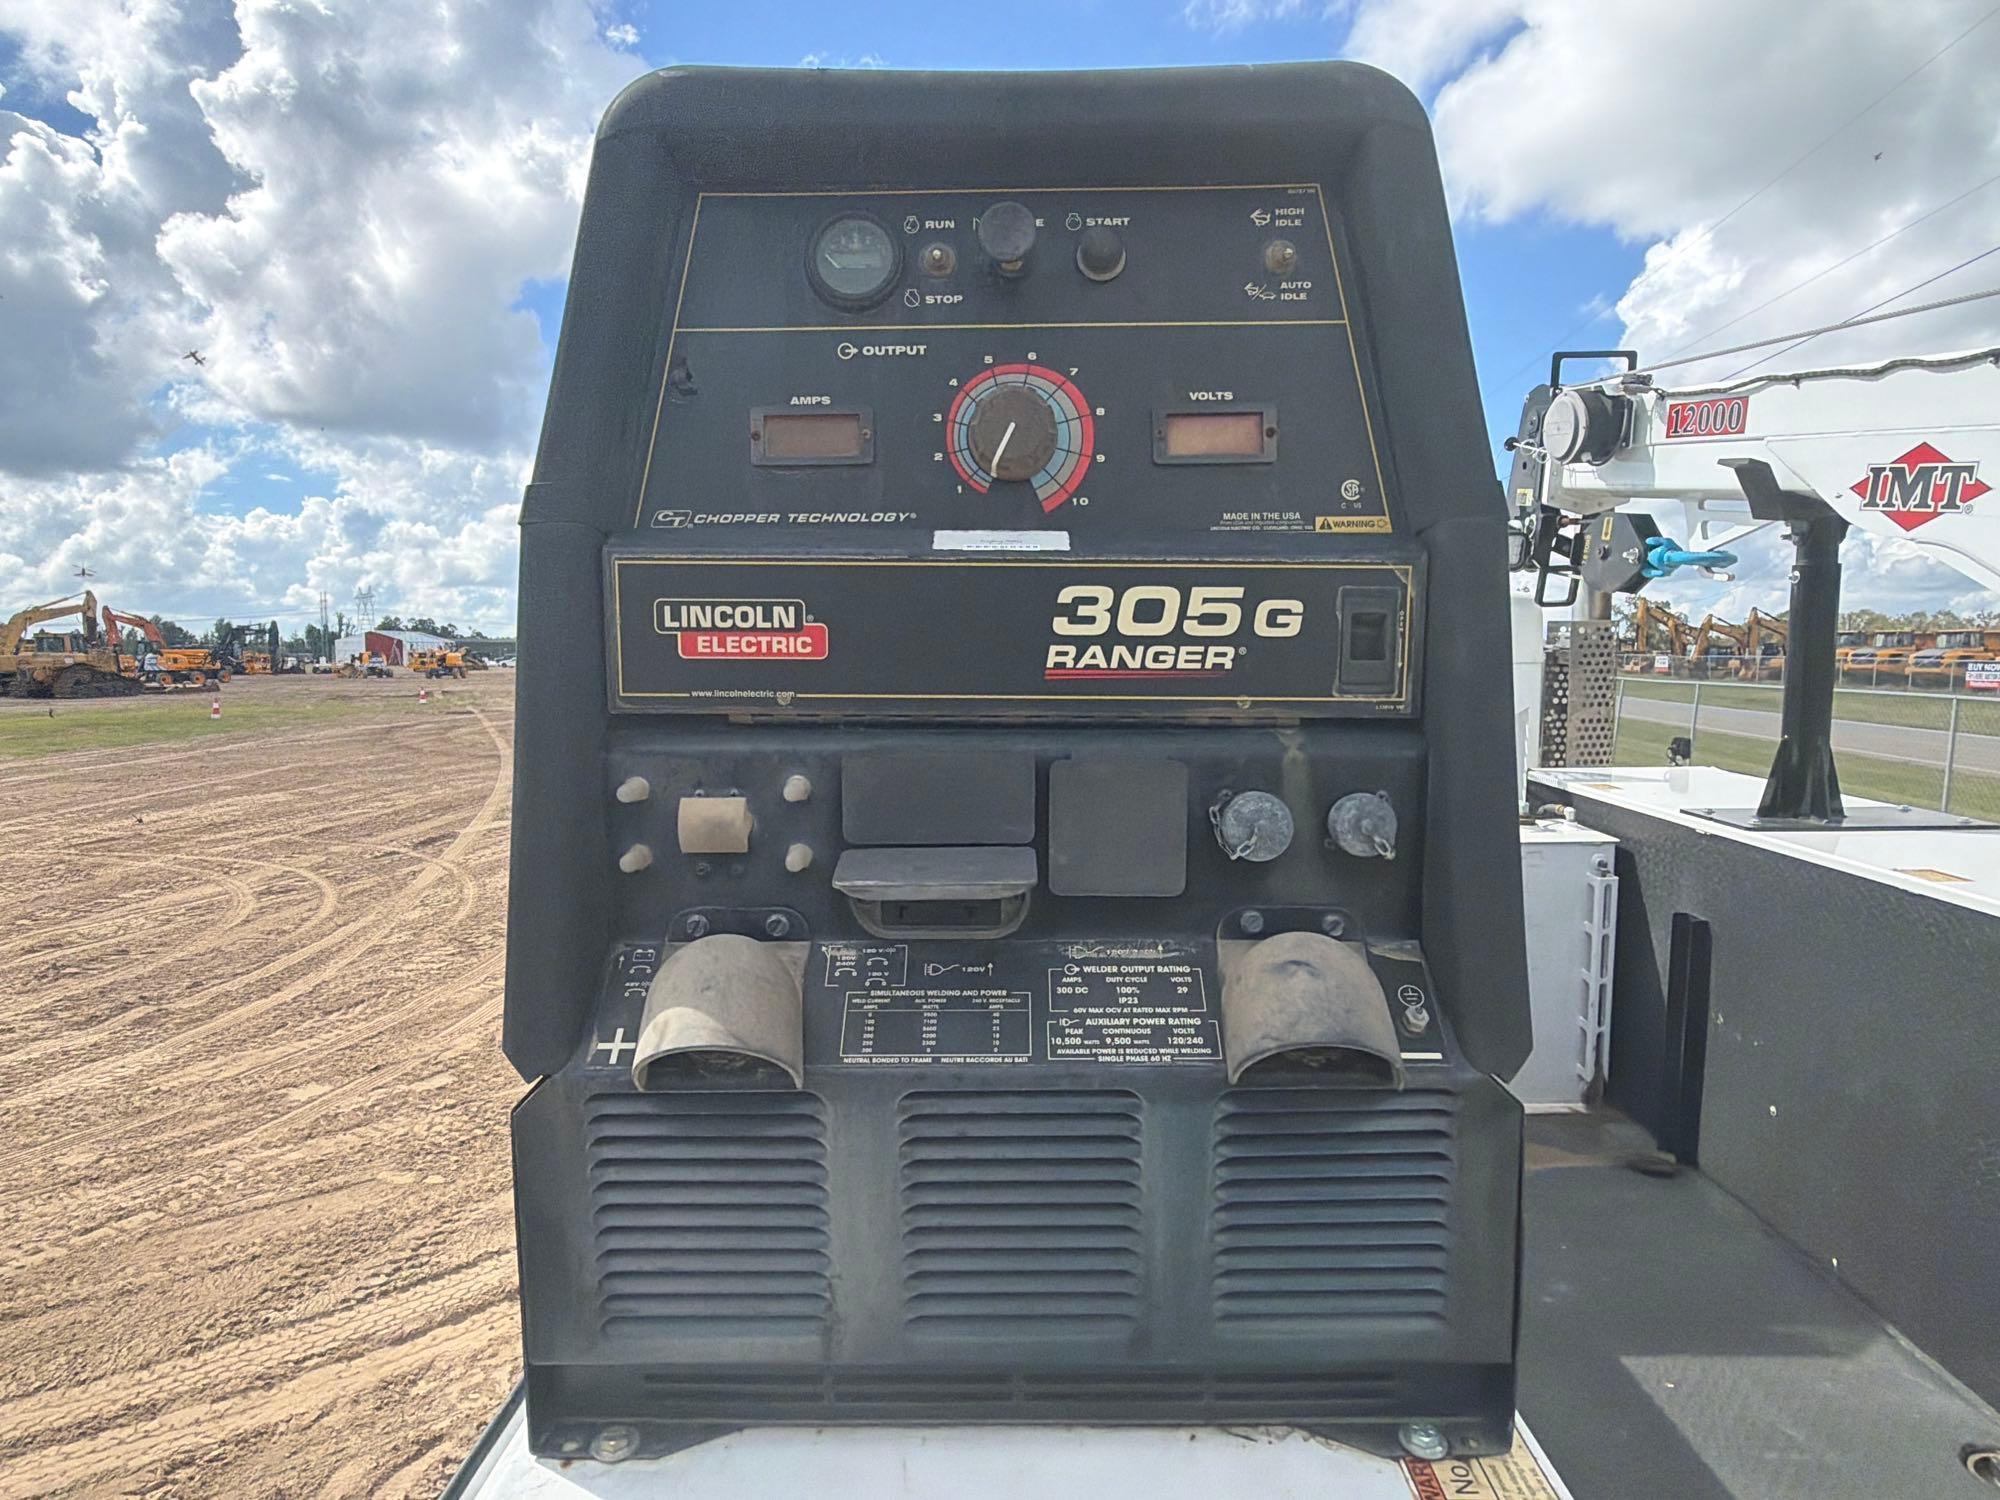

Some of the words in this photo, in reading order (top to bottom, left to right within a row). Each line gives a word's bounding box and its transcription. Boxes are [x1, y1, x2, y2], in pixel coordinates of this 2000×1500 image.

[1275, 207, 1305, 216] HIGH
[925, 219, 955, 229] RUN
[1086, 216, 1130, 227] START
[1275, 218, 1302, 227] IDLE
[1280, 281, 1312, 289] AUTO
[925, 294, 963, 305] STOP
[1280, 292, 1308, 301] IDLE
[862, 345, 927, 356] OUTPUT
[984, 355, 994, 364] 5
[1027, 352, 1037, 360] 6
[1069, 367, 1079, 376] 7
[949, 378, 958, 386] 4
[790, 395, 832, 406] AMPS
[1189, 391, 1234, 401] VOLTS
[1096, 407, 1106, 416] 8
[933, 413, 942, 422] 3
[1668, 398, 1744, 437] 12000
[934, 452, 943, 461] 2
[1096, 454, 1106, 463] 9
[956, 485, 963, 494] 1
[1861, 462, 1979, 513] IMT
[1072, 497, 1089, 506] 10
[694, 513, 781, 524] CHOPPER
[1222, 512, 1249, 521] MADE
[1250, 512, 1260, 521] IN
[1261, 512, 1280, 520] THE
[1282, 512, 1301, 520] USA
[1333, 519, 1377, 529] WARNING
[1051, 585, 1245, 637] 305
[1253, 599, 1304, 638] G
[663, 604, 796, 629] LINCOLN
[696, 635, 813, 654] ELECTRIC
[691, 689, 796, 698] www.lincolnelectric.com
[1082, 965, 1119, 973] WELDER
[1120, 965, 1156, 973] OUTPUT
[1157, 965, 1191, 973] RATING
[870, 989, 925, 997] SIMULTANEOUS
[926, 989, 961, 997] WELDING
[962, 989, 979, 997] AND
[980, 989, 1008, 997] POWER
[1056, 986, 1074, 994] 300
[1075, 986, 1089, 994] DC
[1116, 986, 1140, 994] 100%
[1176, 986, 1189, 994] 29
[1118, 996, 1139, 1004] IP23
[1085, 1018, 1131, 1026] AUXILIARY
[1167, 1017, 1202, 1025] RATING
[1050, 1037, 1082, 1046] 10,500
[1105, 1037, 1132, 1046] 9,500
[1167, 1036, 1204, 1045] 120/240
